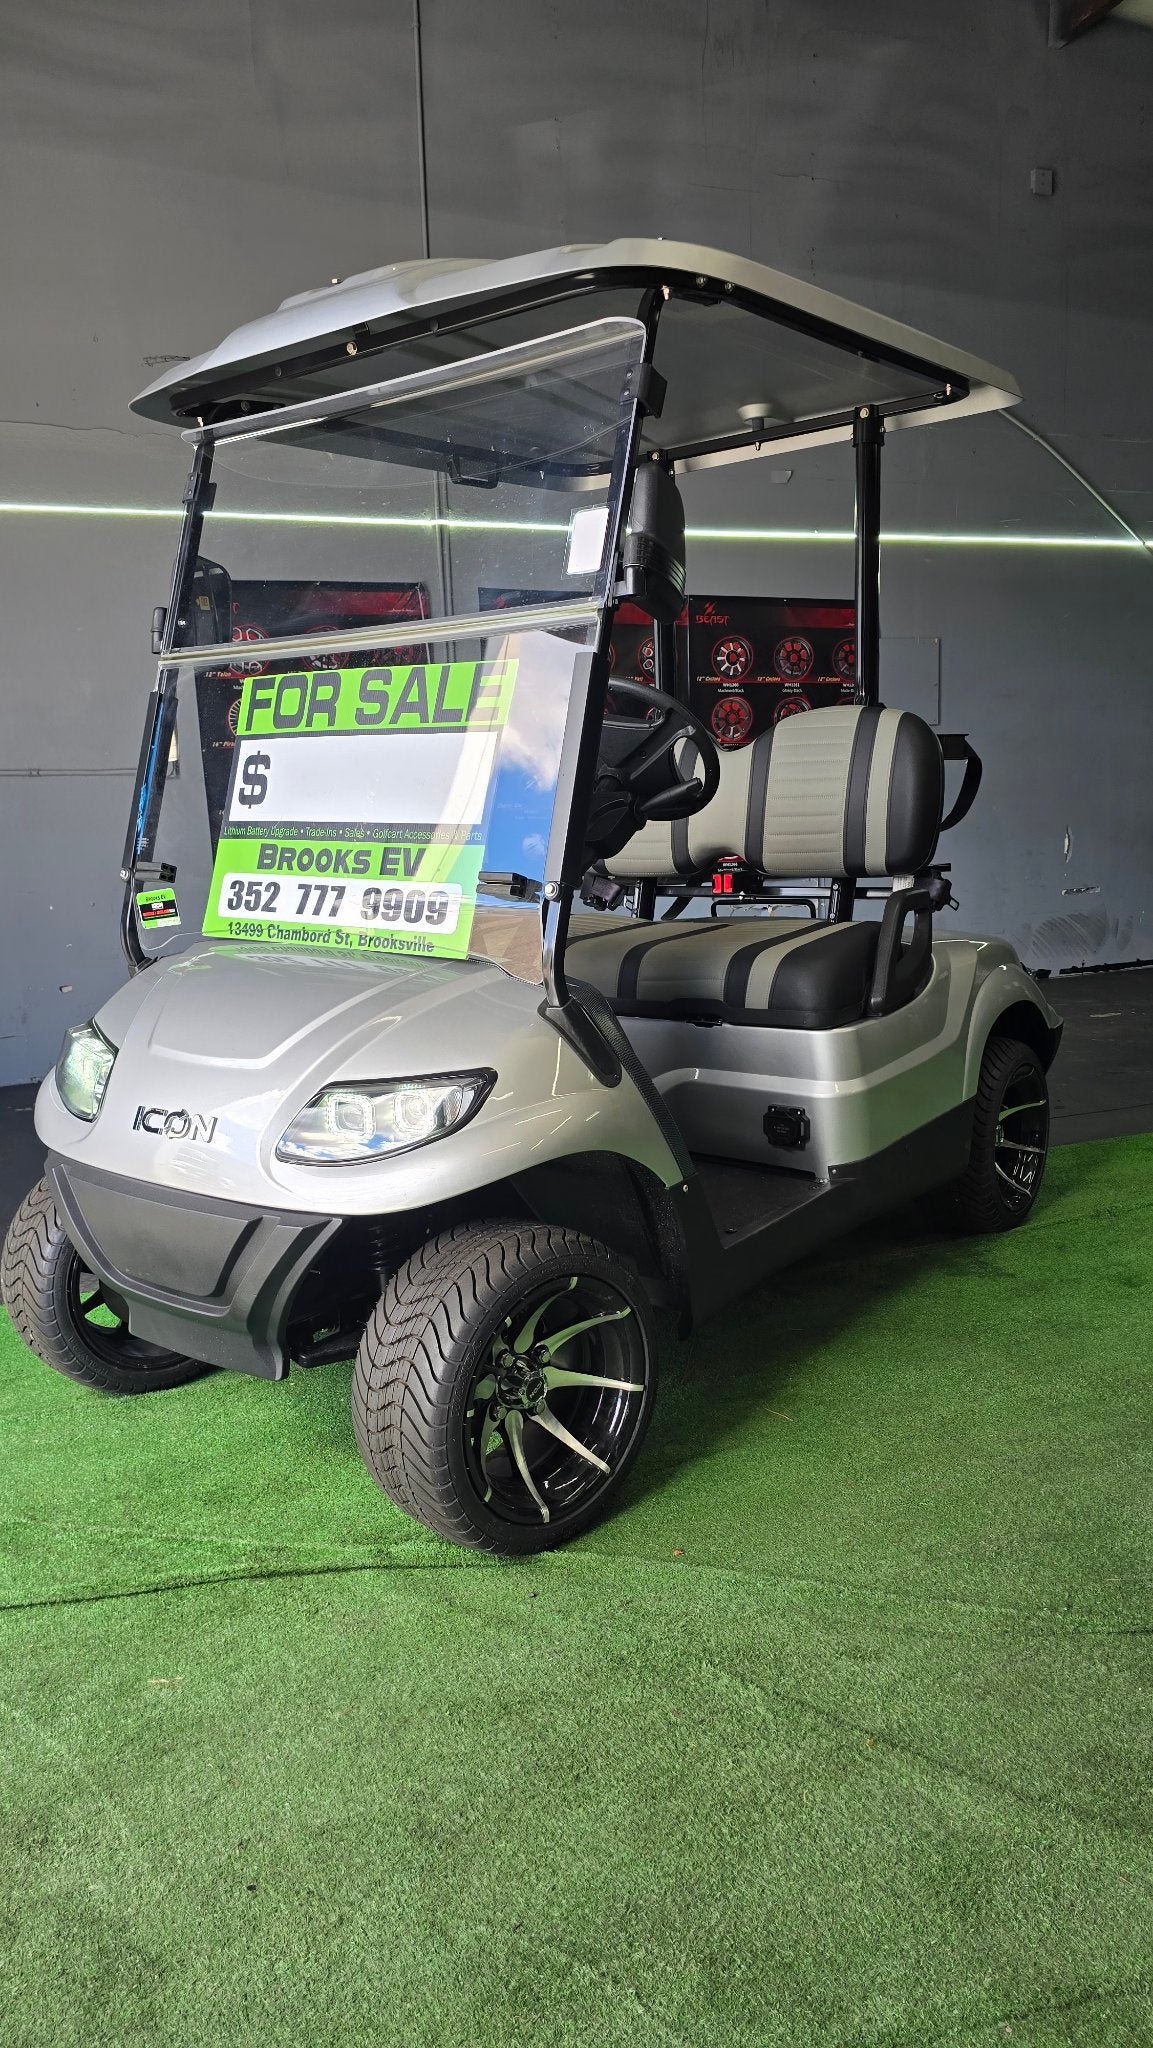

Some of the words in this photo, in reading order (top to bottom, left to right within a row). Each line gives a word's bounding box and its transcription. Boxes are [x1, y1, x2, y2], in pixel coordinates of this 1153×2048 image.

[696, 615, 731, 627] BEAST
[245, 672, 342, 731] FOR
[354, 661, 507, 726] SALE
[238, 751, 271, 809] $
[224, 825, 246, 836] Lithium
[247, 825, 270, 838] Battery
[270, 826, 298, 838] Upgrade
[305, 826, 337, 838] Trade-Ins
[344, 827, 365, 838] Sales
[372, 828, 402, 840] Golfcart
[404, 829, 450, 840] Accessories
[460, 831, 483, 841] Parts
[257, 843, 372, 875] BROOKS
[379, 846, 428, 877] EV
[227, 880, 281, 913] 352
[295, 885, 347, 918] 777
[360, 887, 449, 926] 9909
[228, 922, 264, 938] 13499
[266, 924, 331, 944] Chambord
[335, 928, 353, 948] St,
[357, 931, 435, 953] Brooksville
[132, 1105, 219, 1144] ICON
